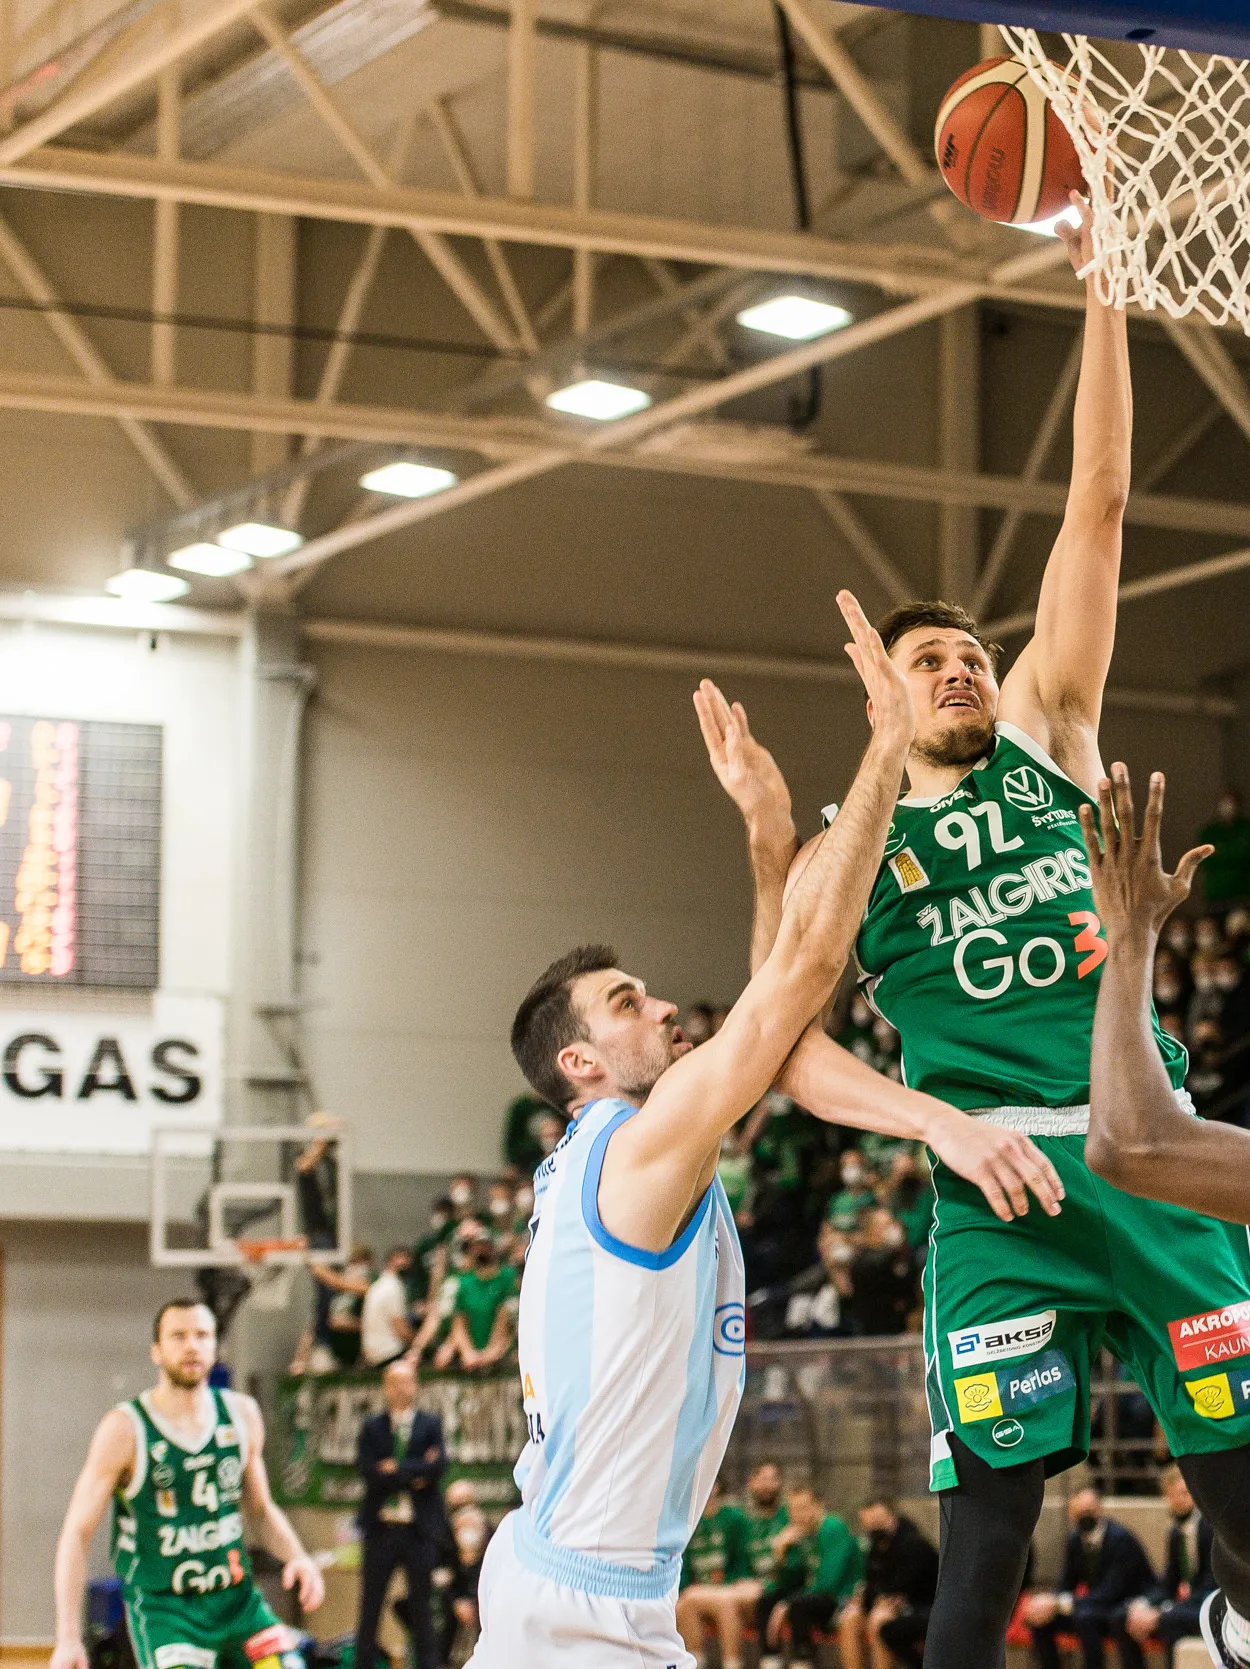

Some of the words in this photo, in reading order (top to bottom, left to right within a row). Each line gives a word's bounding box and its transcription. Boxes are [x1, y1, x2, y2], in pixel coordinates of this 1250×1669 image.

[930, 788, 978, 813] OlyBe
[934, 801, 1025, 871] 92
[917, 848, 1095, 947] ŽALGIRIS
[1009, 1366, 1062, 1399] Perlas
[191, 1470, 219, 1512] 4
